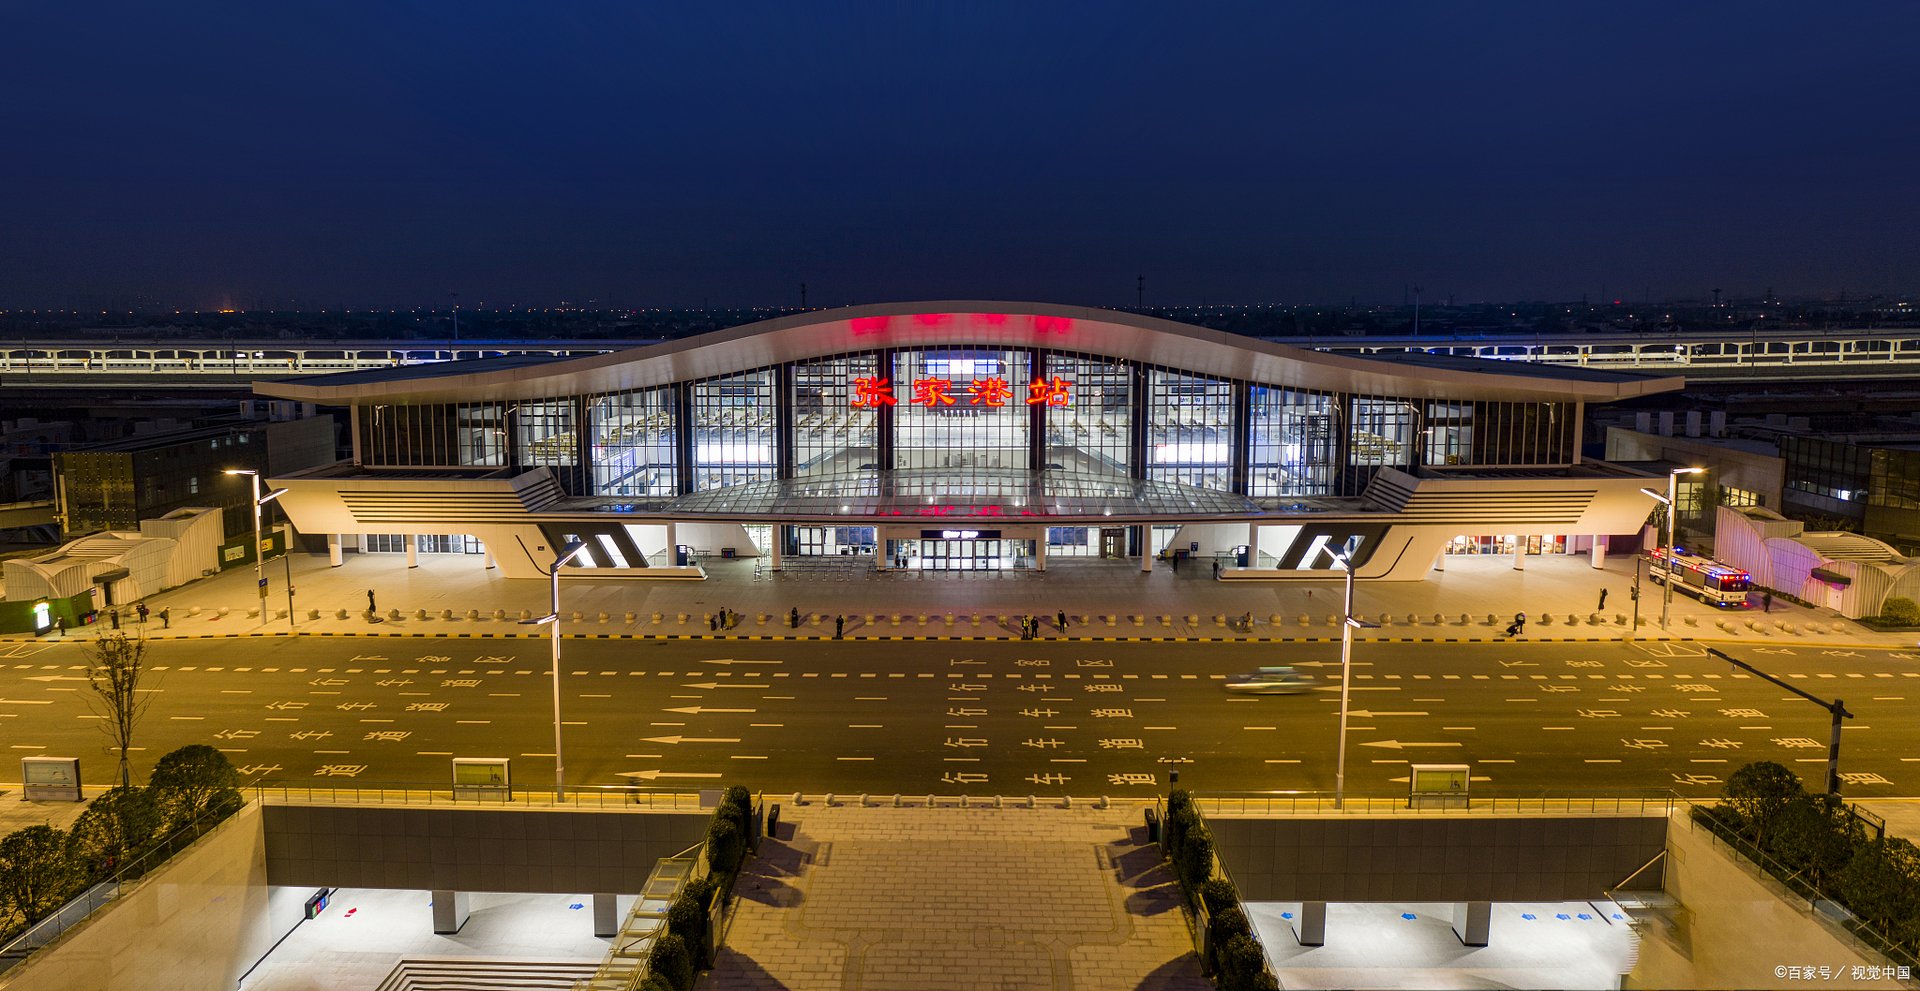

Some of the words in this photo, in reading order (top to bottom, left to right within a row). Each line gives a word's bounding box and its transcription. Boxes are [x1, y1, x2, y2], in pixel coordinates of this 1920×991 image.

[851, 376, 1072, 408] 张家港站
[950, 658, 1114, 667] 下客区
[308, 678, 483, 688] 行车道
[948, 682, 1124, 693] 行车道
[1538, 683, 1720, 693] 行车道
[265, 702, 451, 713] 行车道
[946, 707, 1134, 718] 行车道
[1576, 707, 1770, 718] 行车道
[213, 730, 413, 742] 行车道
[943, 737, 1145, 750] 行车道
[1620, 737, 1828, 750] 行车道
[941, 771, 1158, 786] 行车道
